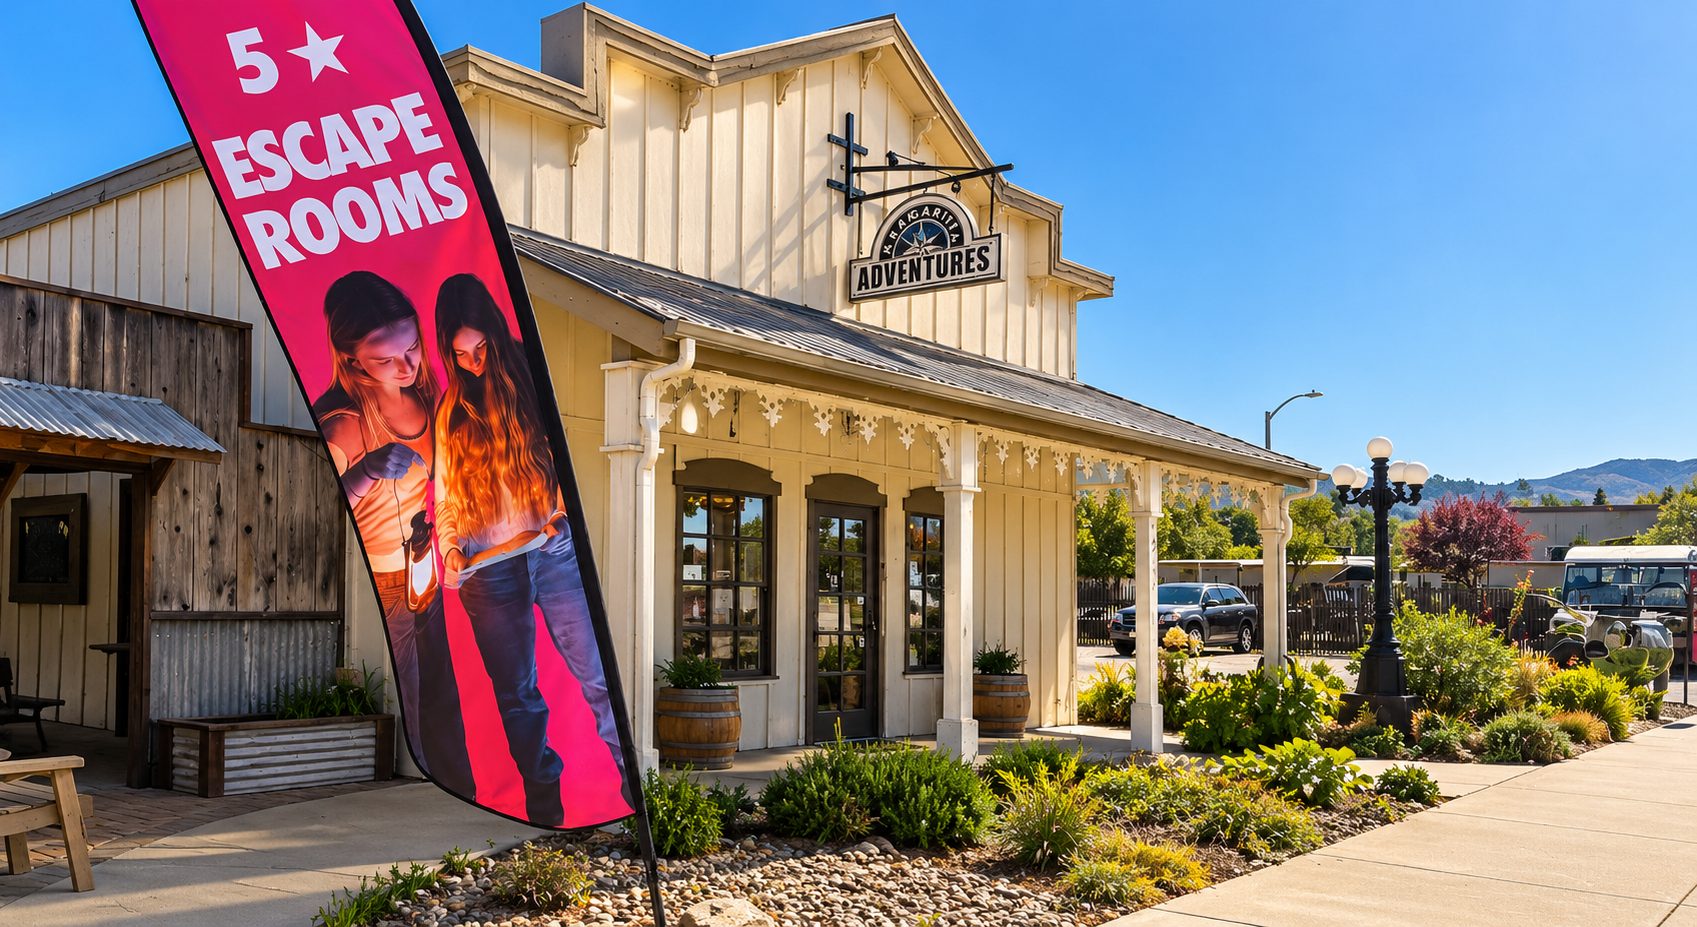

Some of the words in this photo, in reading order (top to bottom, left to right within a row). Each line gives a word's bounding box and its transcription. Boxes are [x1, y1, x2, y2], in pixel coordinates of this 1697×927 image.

[225, 27, 279, 94] 5
[212, 92, 444, 199] ESCAPE
[242, 162, 468, 270] ROOMS
[857, 245, 990, 292] ADVENTURES
